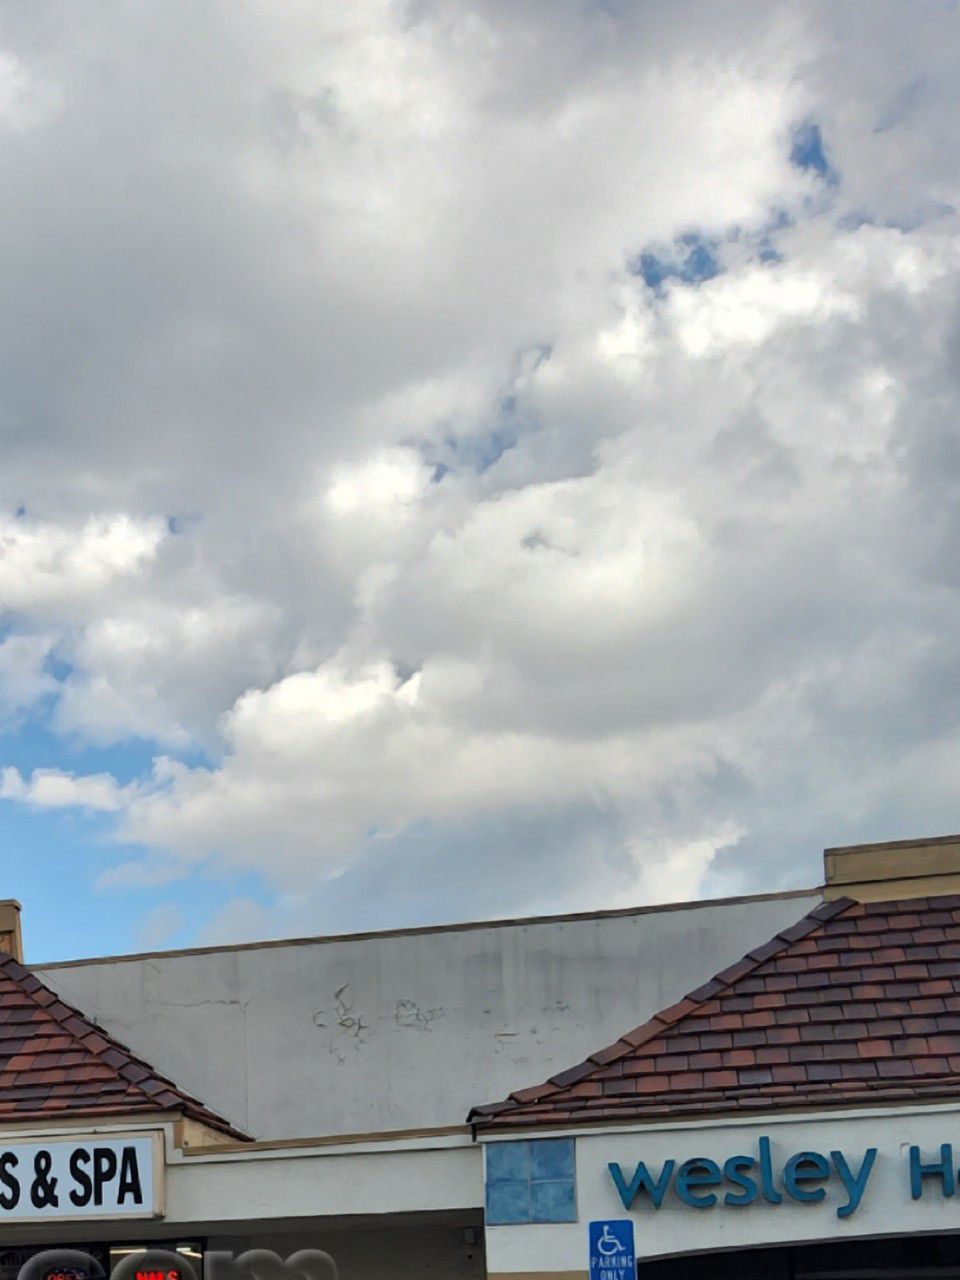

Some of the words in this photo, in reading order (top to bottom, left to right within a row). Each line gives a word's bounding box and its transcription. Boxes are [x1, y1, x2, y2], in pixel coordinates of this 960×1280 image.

[30, 1149, 59, 1208] &
[69, 1146, 143, 1207] SPA
[608, 1136, 878, 1219] wesley
[909, 1143, 960, 1201] H
[591, 1255, 633, 1269] PARKING
